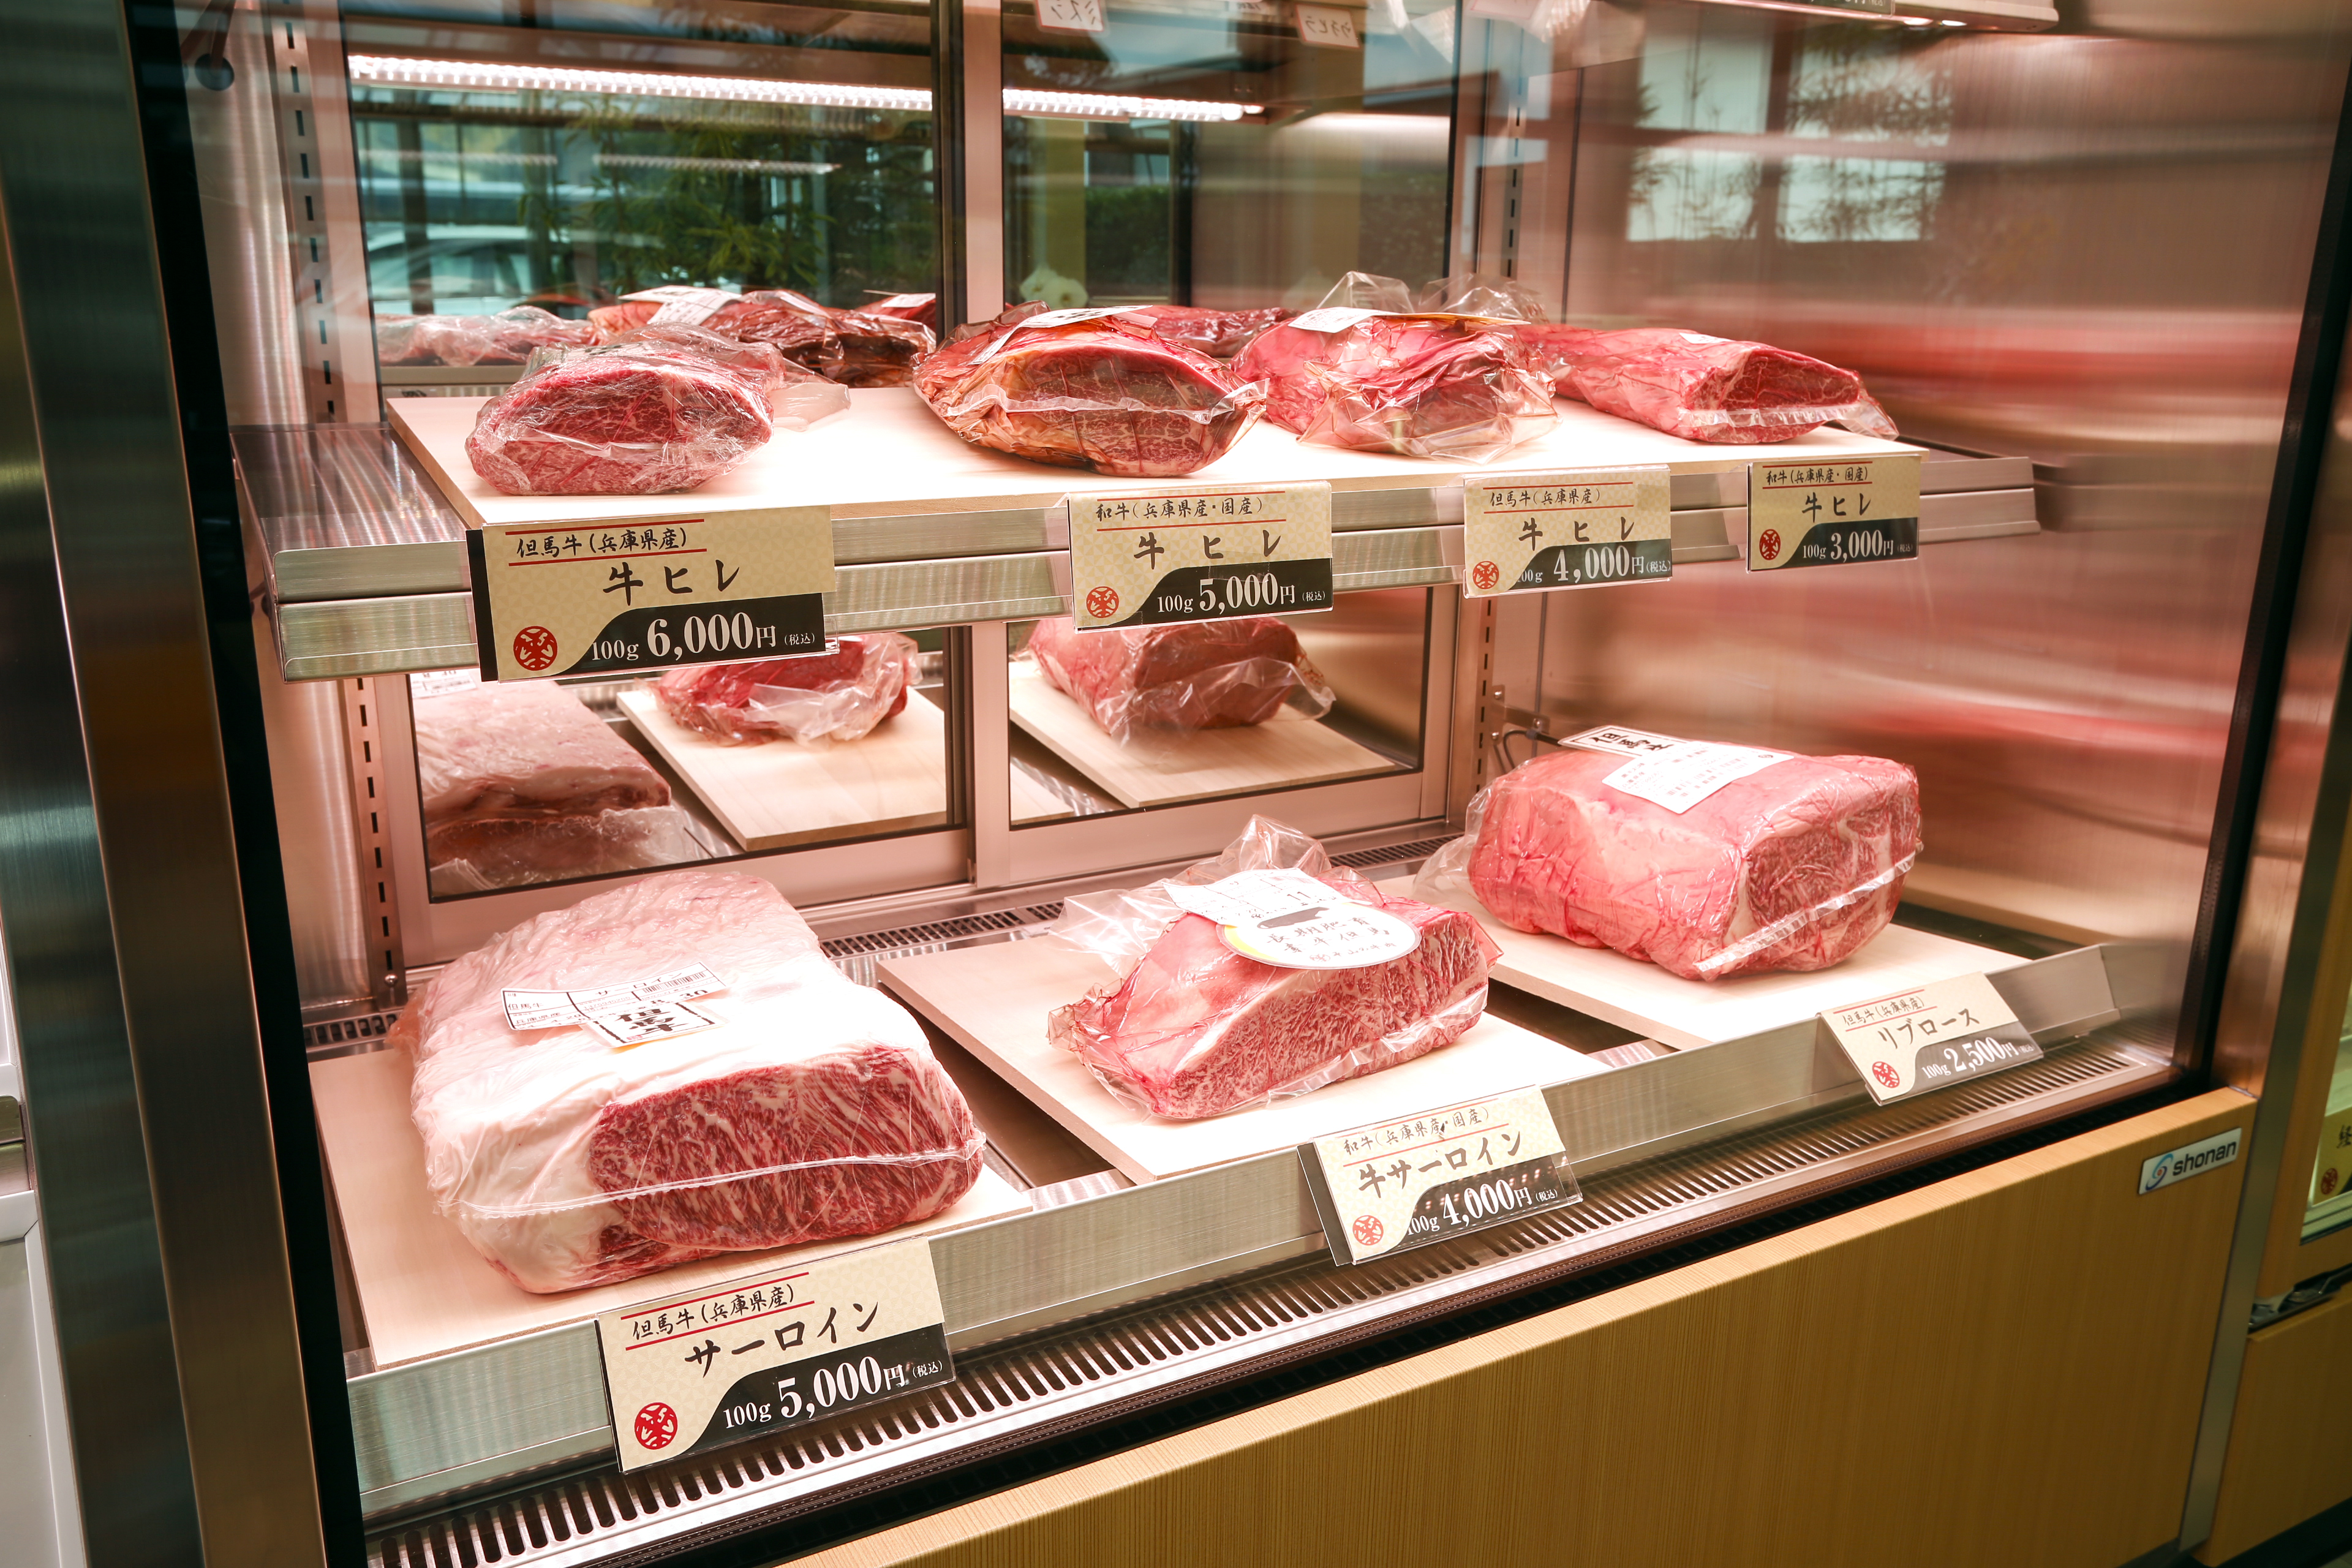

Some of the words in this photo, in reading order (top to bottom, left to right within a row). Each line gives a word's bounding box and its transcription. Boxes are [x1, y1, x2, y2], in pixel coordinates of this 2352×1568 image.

[1096, 497, 1263, 522] 和牛（兵庫県産・国産）
[1490, 488, 1600, 508] 但馬牛（兵庫県産）
[1801, 492, 1871, 523] 牛ヒレ
[517, 527, 688, 557] 但馬牛（兵庫県産）
[1134, 529, 1281, 570] 牛ヒレ
[1518, 516, 1635, 551] 牛ヒレ
[1803, 545, 1826, 559] 100g
[1830, 529, 1894, 563] 3,000円
[603, 560, 740, 606] 牛ヒレ
[1518, 570, 1543, 582] 00g
[1553, 545, 1644, 584] 4,000円
[1158, 594, 1194, 613] 100g
[1199, 573, 1295, 614] 5,000円
[1302, 590, 1325, 602] （税込）
[592, 639, 639, 662] 100g
[647, 611, 776, 661] 6,000円
[783, 632, 815, 646] （税込）
[595, 972, 682, 997] サーロイン
[614, 1008, 689, 1037] 但馬牛
[1877, 1008, 1980, 1049] リブロース
[1921, 1061, 1951, 1079] 100g
[1943, 1036, 2020, 1072] 2,500円
[1358, 1131, 1520, 1199] 牛サーロイン
[2173, 1141, 2237, 1176] shonan
[1442, 1179, 1532, 1227] 4,000円
[1535, 1188, 1558, 1202] （税込）
[632, 1284, 794, 1340] 但馬牛（兵庫県産）
[684, 1302, 878, 1379] サーロイン
[723, 1401, 771, 1429] 100g
[777, 1355, 905, 1419] 5,000円
[911, 1359, 943, 1379] （税込）
